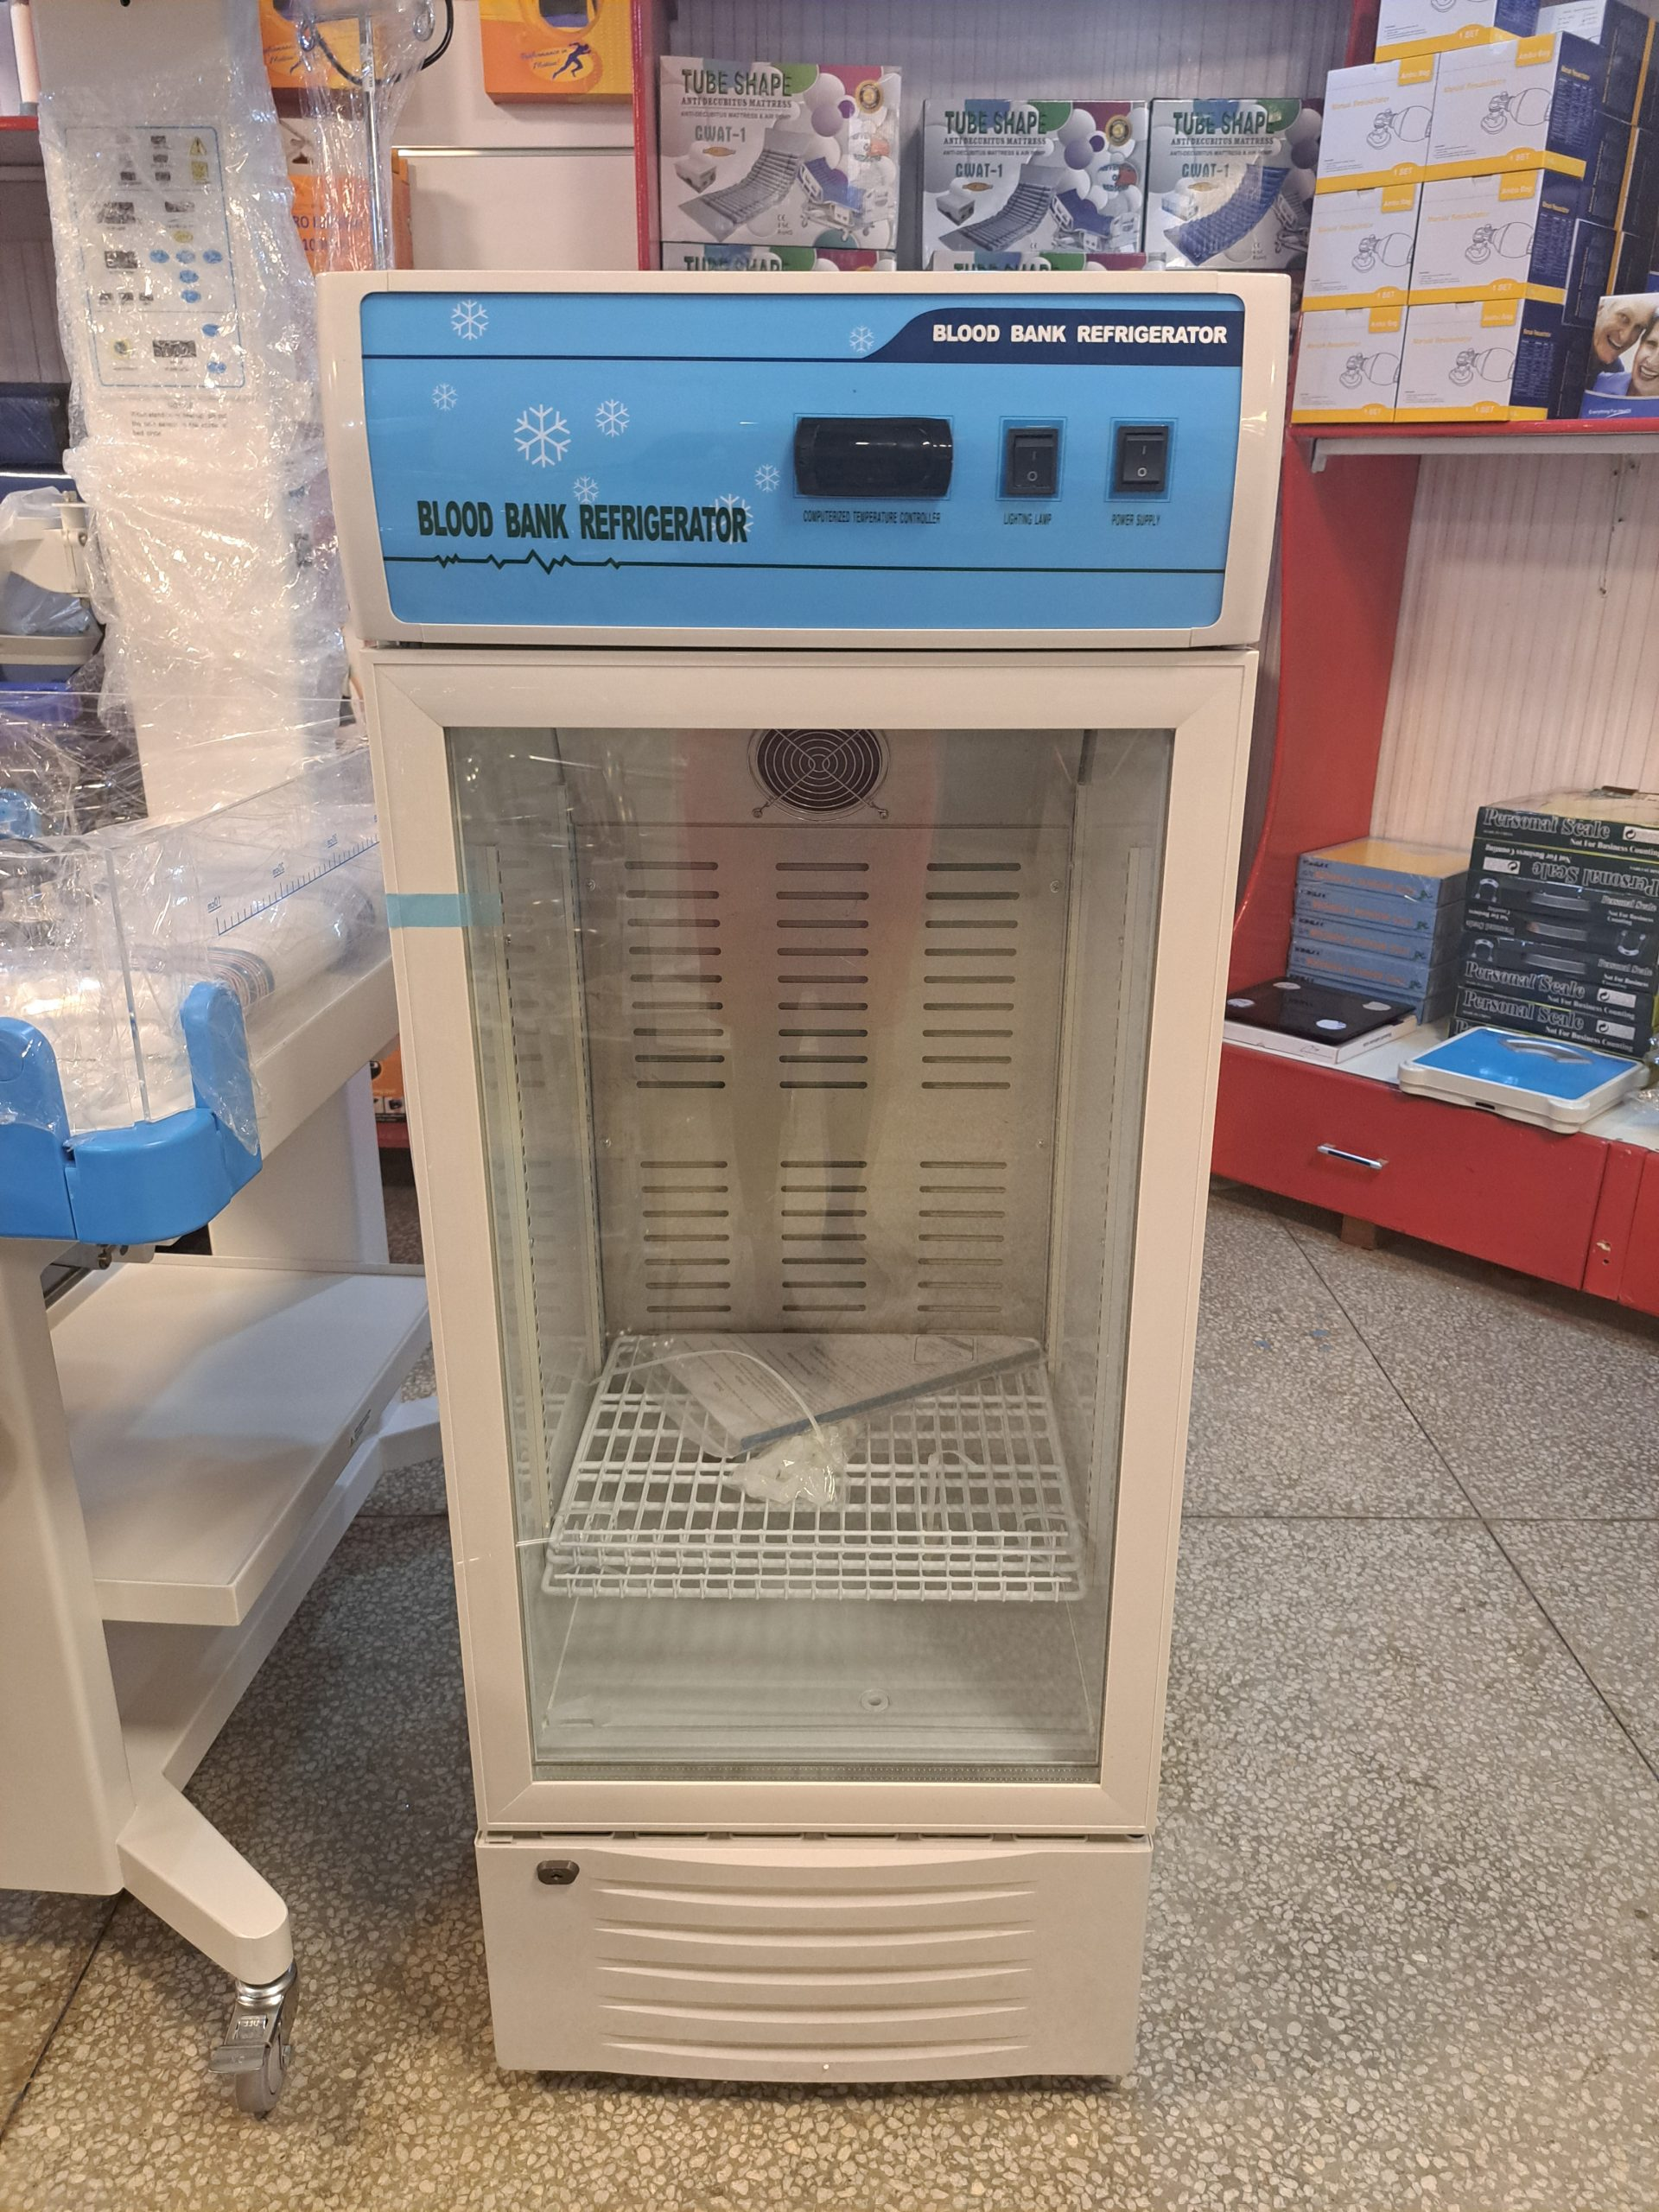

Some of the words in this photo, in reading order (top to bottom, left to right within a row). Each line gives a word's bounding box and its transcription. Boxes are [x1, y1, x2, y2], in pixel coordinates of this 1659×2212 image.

[682, 69, 728, 94] TUBE
[734, 70, 792, 97] SHAPE
[749, 99, 792, 109] MATTRESS
[944, 111, 987, 135] TUBE
[994, 111, 1047, 135] SHAPE
[1173, 111, 1216, 135] TUBE
[1222, 111, 1274, 135] SHAPE
[932, 324, 1000, 342] BLOOD
[1010, 325, 1066, 343] BANK
[1077, 326, 1228, 344] REFRIGERATOR
[416, 500, 493, 537] BLOOD
[505, 502, 569, 539] BANK
[579, 504, 747, 543] REFRIGERATOR
[803, 510, 849, 523] COMPUTERIZED
[853, 511, 897, 524] TEMPERATURE
[899, 512, 940, 524] CONTROLLER
[1003, 512, 1033, 525] LIGHTING
[1034, 513, 1052, 526] LAMP
[1111, 514, 1135, 526] POWER
[1135, 514, 1160, 526] SUPPLY
[1483, 808, 1559, 834] Personal
[1560, 818, 1611, 840] Scale
[1485, 844, 1515, 855] Counting
[1516, 849, 1545, 859] Business
[1584, 840, 1596, 849] For
[1598, 841, 1628, 852] Business
[1532, 861, 1580, 884] Scale
[1582, 868, 1659, 897] Personal
[1601, 895, 1635, 909] Personal
[1465, 961, 1536, 991] Personal
[1539, 975, 1586, 1000] Scale
[1464, 991, 1534, 1020] Personal
[1537, 1006, 1585, 1031] Scale
[1560, 997, 1573, 1006] For
[1573, 999, 1603, 1012] Business
[1604, 1006, 1636, 1020] Counting
[1559, 1028, 1570, 1037] For
[1572, 1030, 1601, 1043] Business
[1602, 1038, 1633, 1052] Counting
